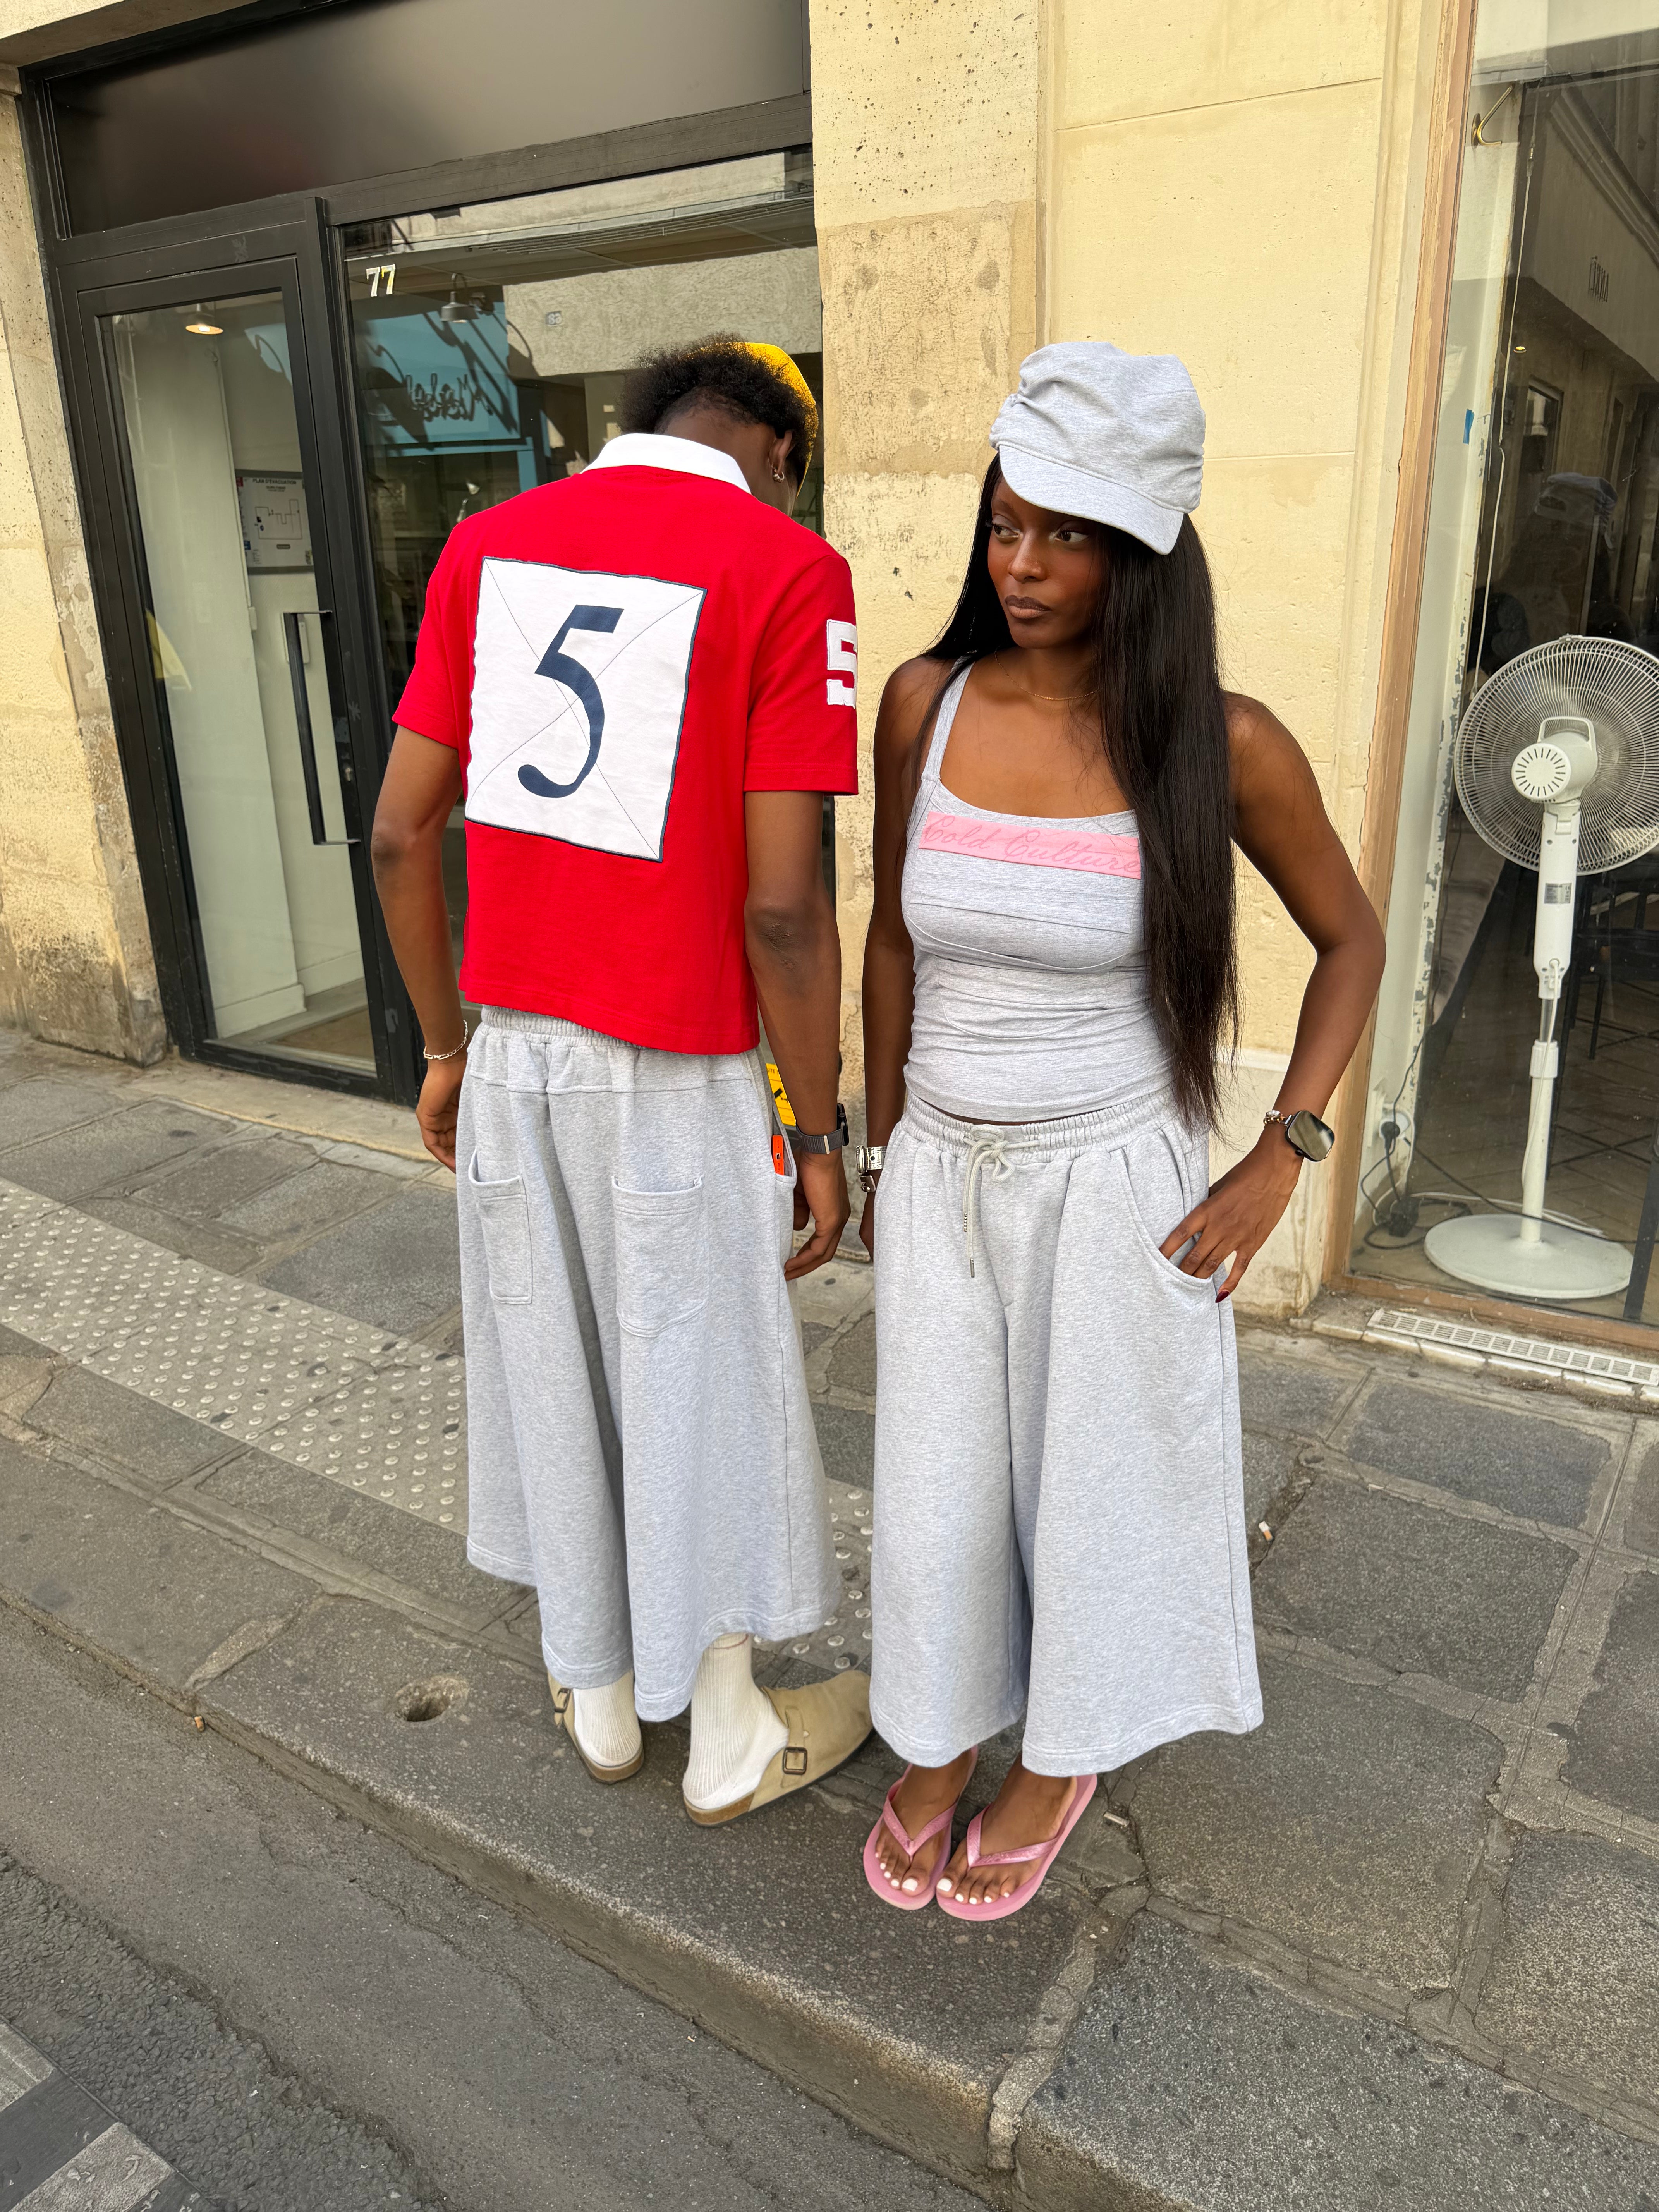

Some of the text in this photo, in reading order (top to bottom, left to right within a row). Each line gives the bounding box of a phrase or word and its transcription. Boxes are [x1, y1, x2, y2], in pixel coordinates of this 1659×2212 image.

[366, 264, 396, 297] 77
[826, 619, 858, 709] 5
[518, 604, 625, 798] 5
[923, 815, 1140, 872] Cold Culture
